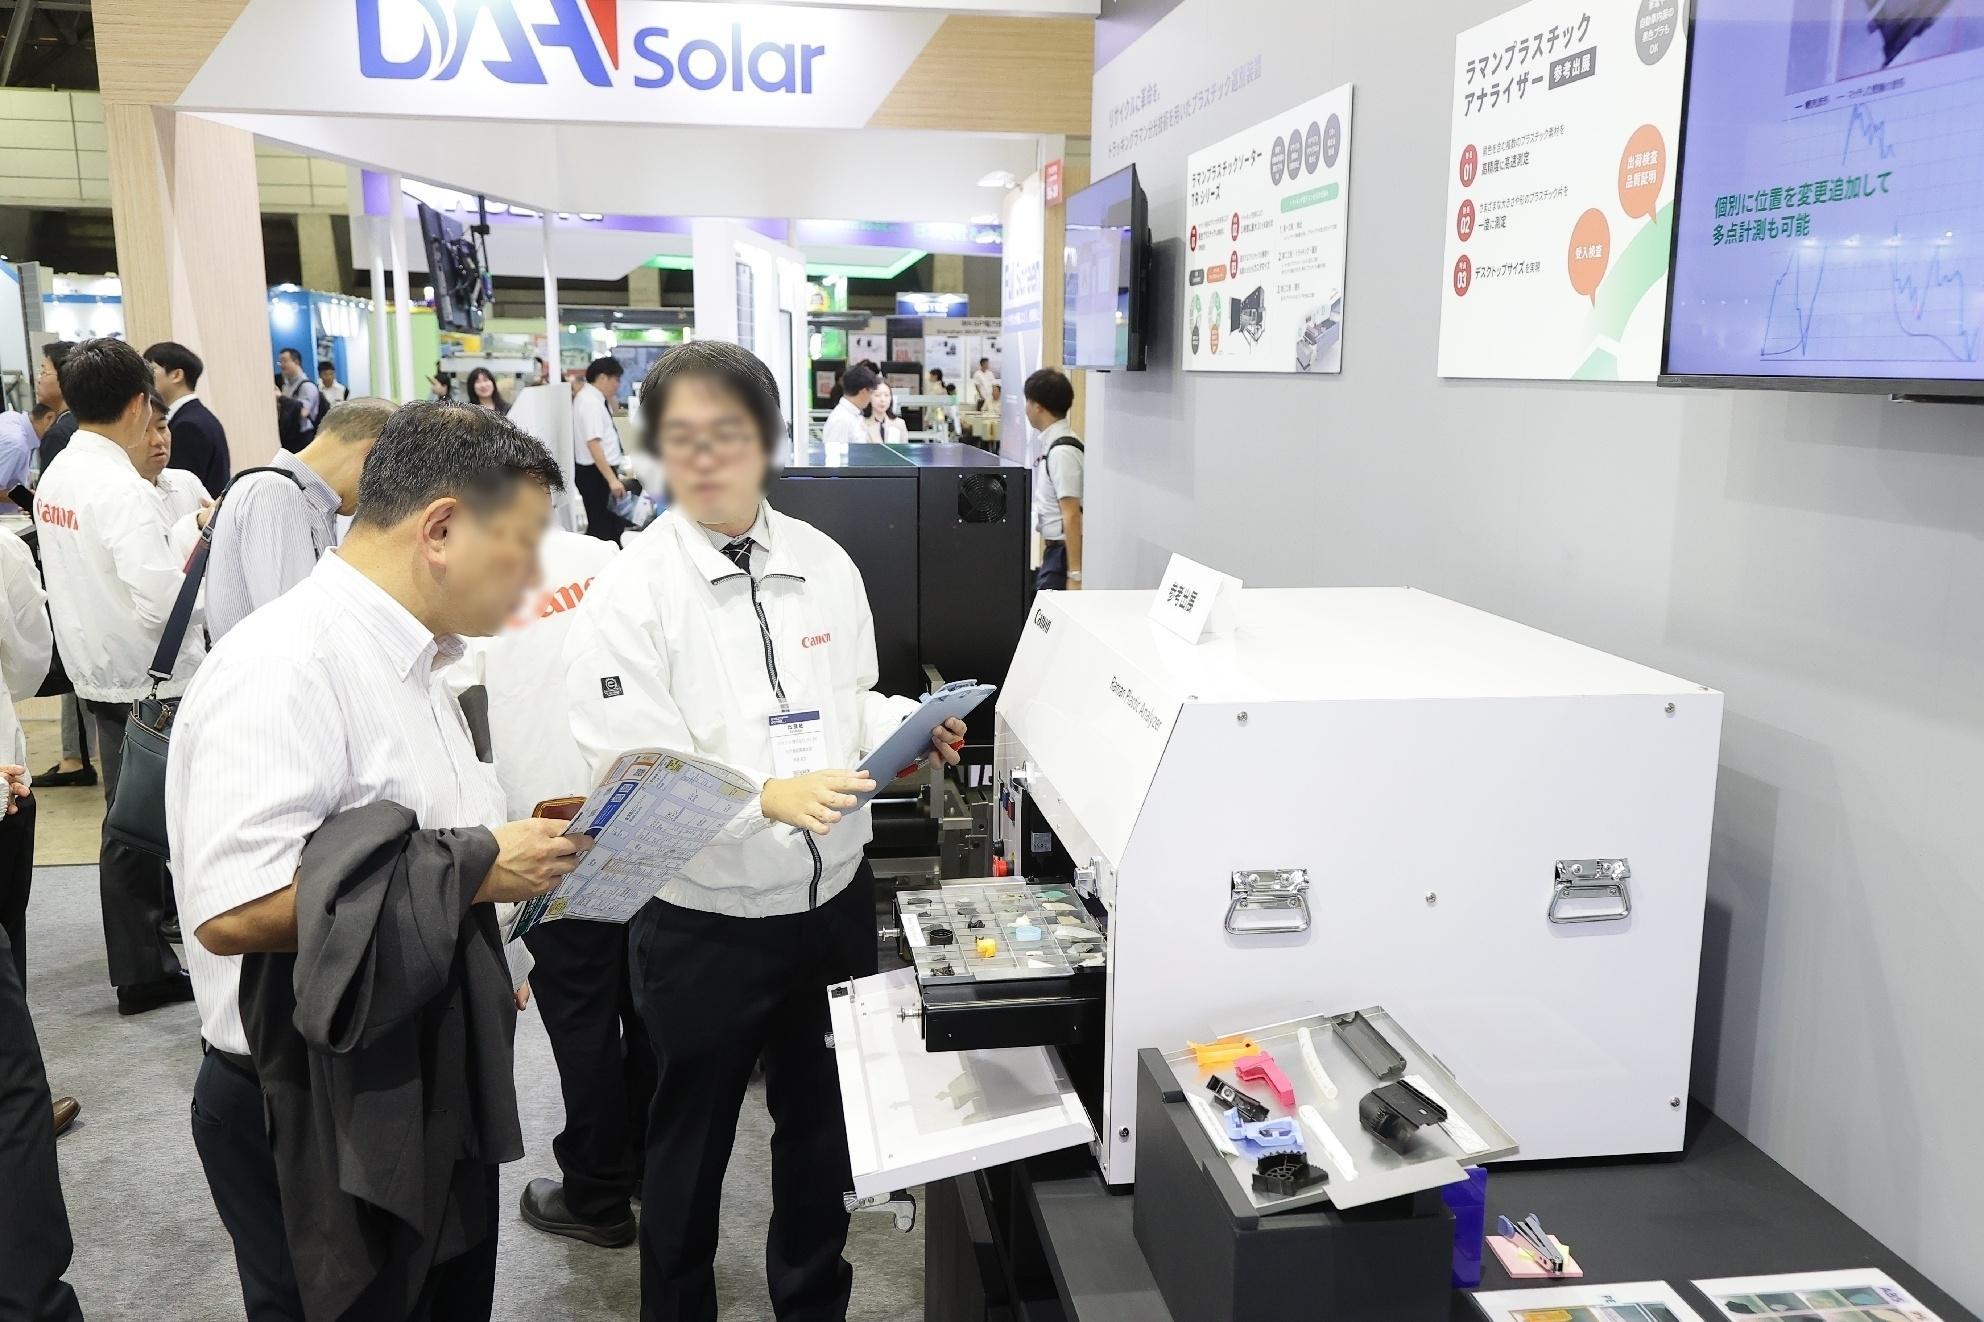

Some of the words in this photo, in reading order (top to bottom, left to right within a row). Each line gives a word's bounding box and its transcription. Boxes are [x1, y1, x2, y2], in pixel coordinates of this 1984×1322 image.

[634, 23, 825, 94] Solar
[1466, 13, 1590, 84] ラマンプラスチック
[1553, 54, 1591, 83] 参考出展
[1465, 71, 1544, 116] アナライザー
[1463, 162, 1473, 181] 01
[1627, 150, 1658, 170] 出荷検査
[1625, 169, 1657, 189] 品質証明
[1714, 171, 1893, 219] 個別に位置を変更追加して
[1460, 216, 1470, 234] 02
[1713, 213, 1811, 247] 多点計測も可能
[1575, 243, 1602, 260] 受入検査
[1457, 272, 1467, 288] 03
[1034, 608, 1051, 634] Canon
[801, 632, 831, 649] Canon
